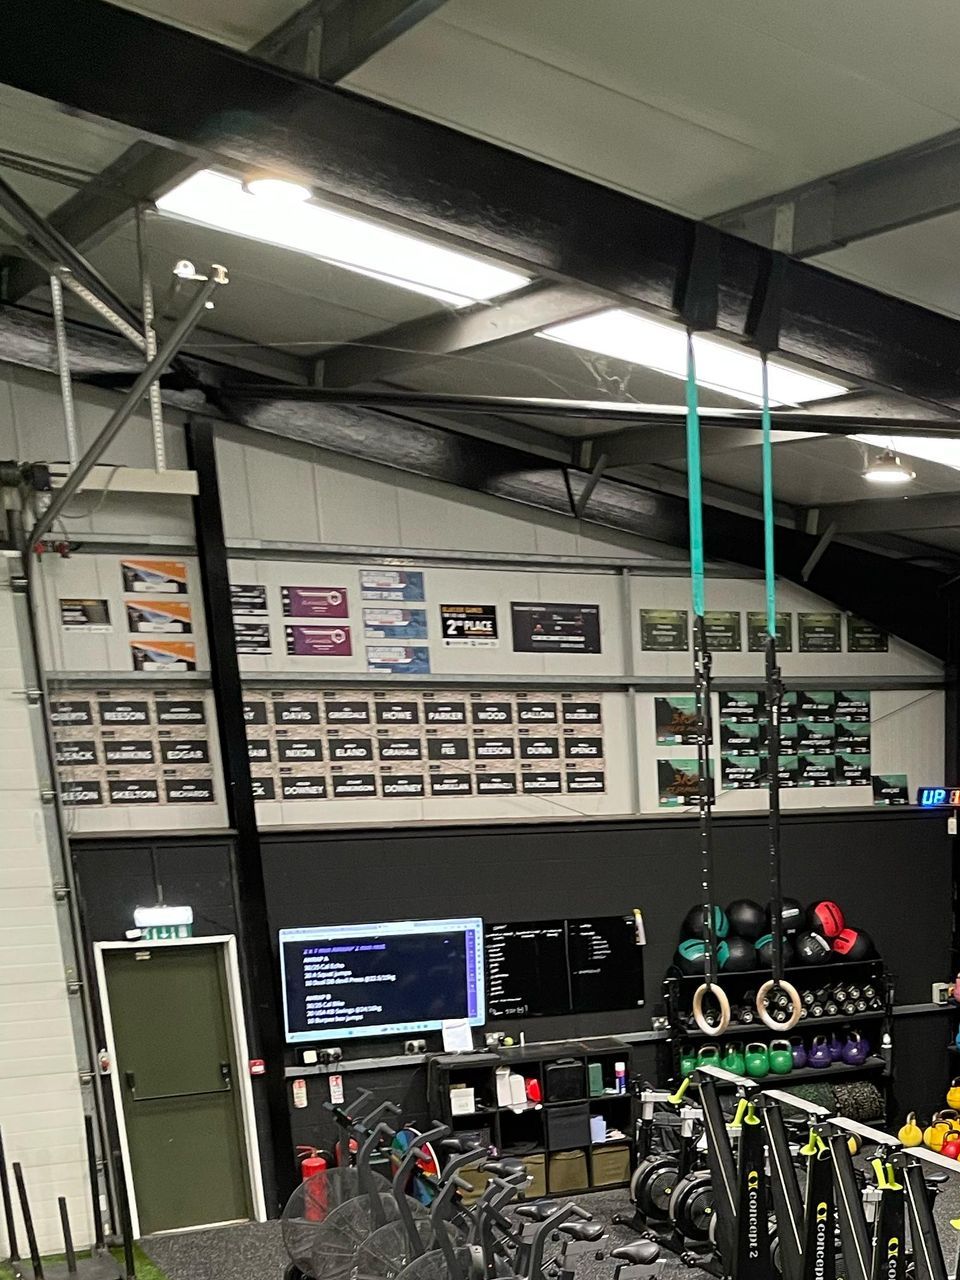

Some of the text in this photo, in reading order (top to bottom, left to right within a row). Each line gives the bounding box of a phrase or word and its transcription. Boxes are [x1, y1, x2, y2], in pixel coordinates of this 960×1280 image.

[463, 620, 493, 631] PLACE
[282, 711, 312, 720] DAVIS
[382, 711, 412, 720] HOWE
[428, 711, 464, 720] PARKER
[478, 711, 508, 720] WOOD
[167, 751, 204, 760] EDGAR
[335, 748, 367, 757] ELAND
[112, 791, 157, 800] SKELTON
[921, 789, 946, 805] UP
[748, 1191, 758, 1248] concept
